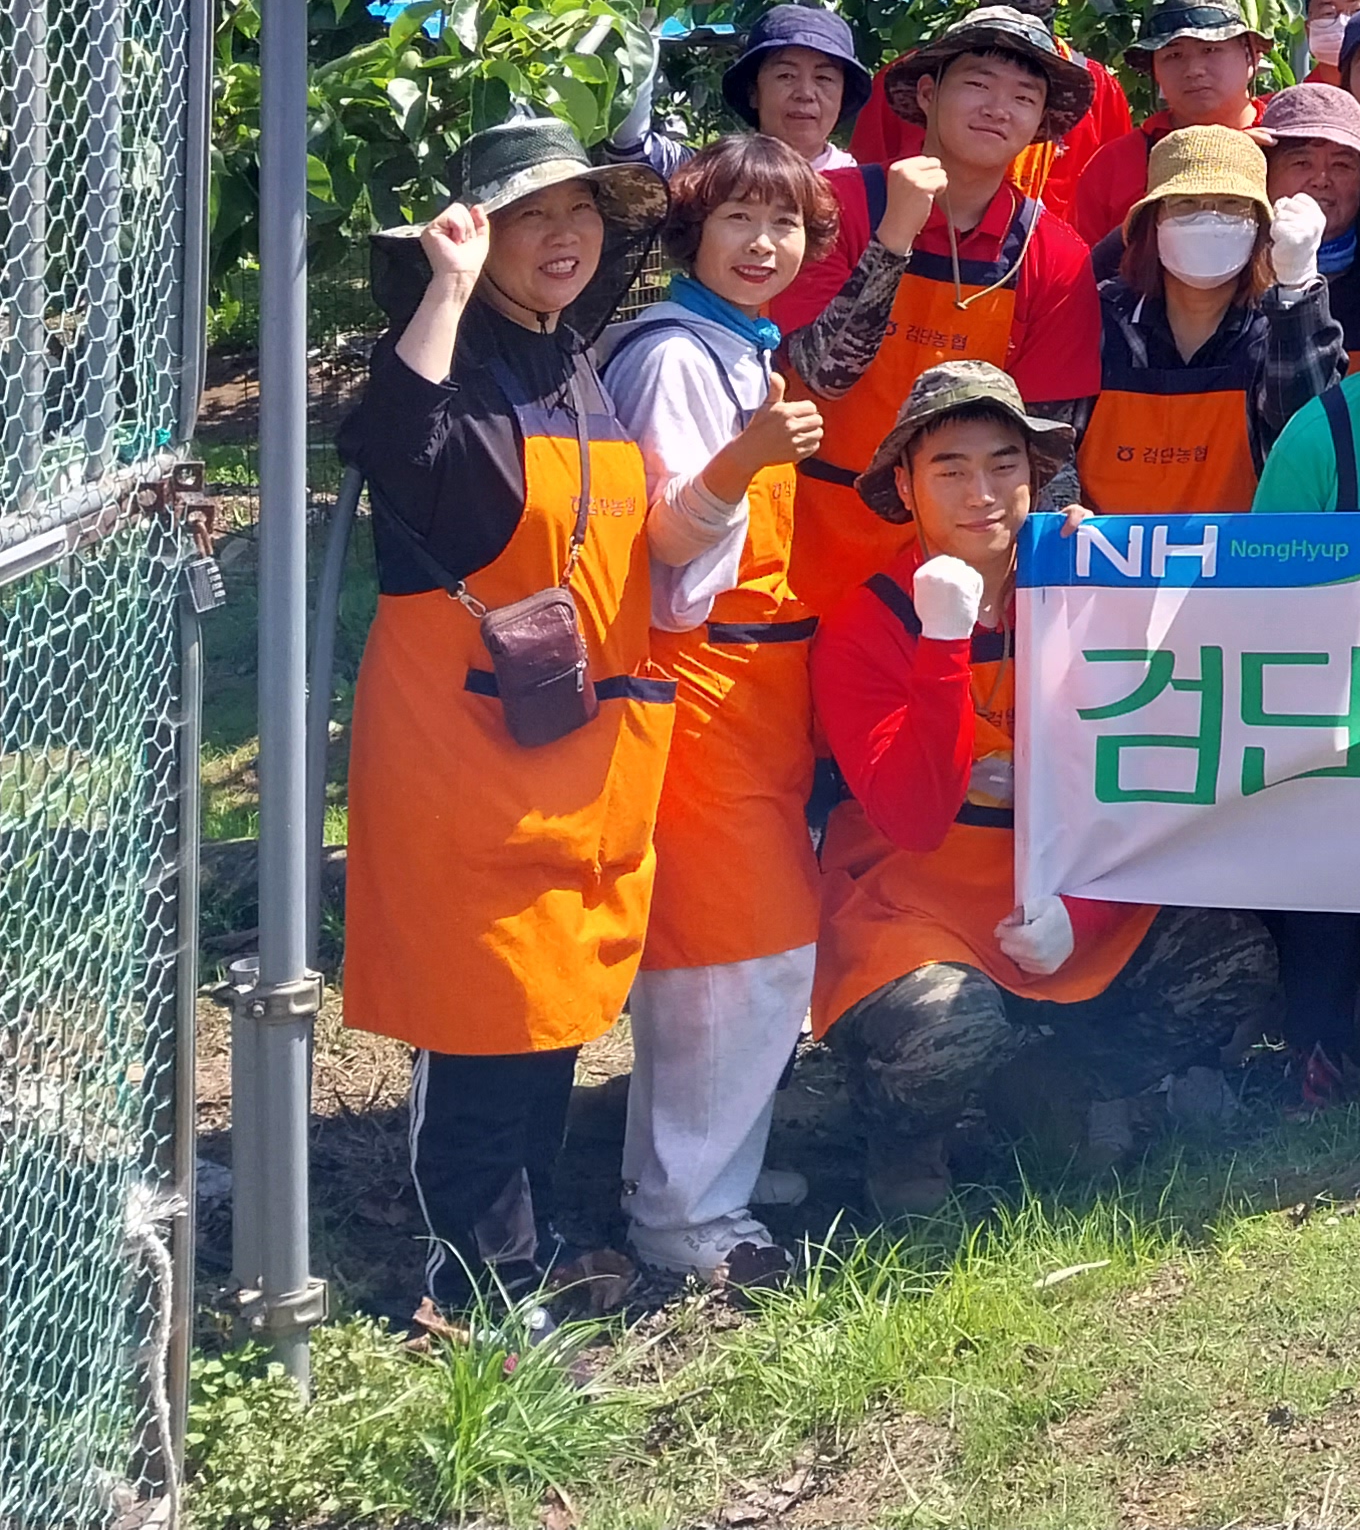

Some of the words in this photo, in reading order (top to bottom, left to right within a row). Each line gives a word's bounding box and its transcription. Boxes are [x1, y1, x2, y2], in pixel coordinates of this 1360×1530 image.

[905, 324, 968, 351] 검단농협
[1143, 446, 1208, 464] 검단농협
[1075, 524, 1218, 578] NH
[1230, 539, 1350, 563] NongHyup
